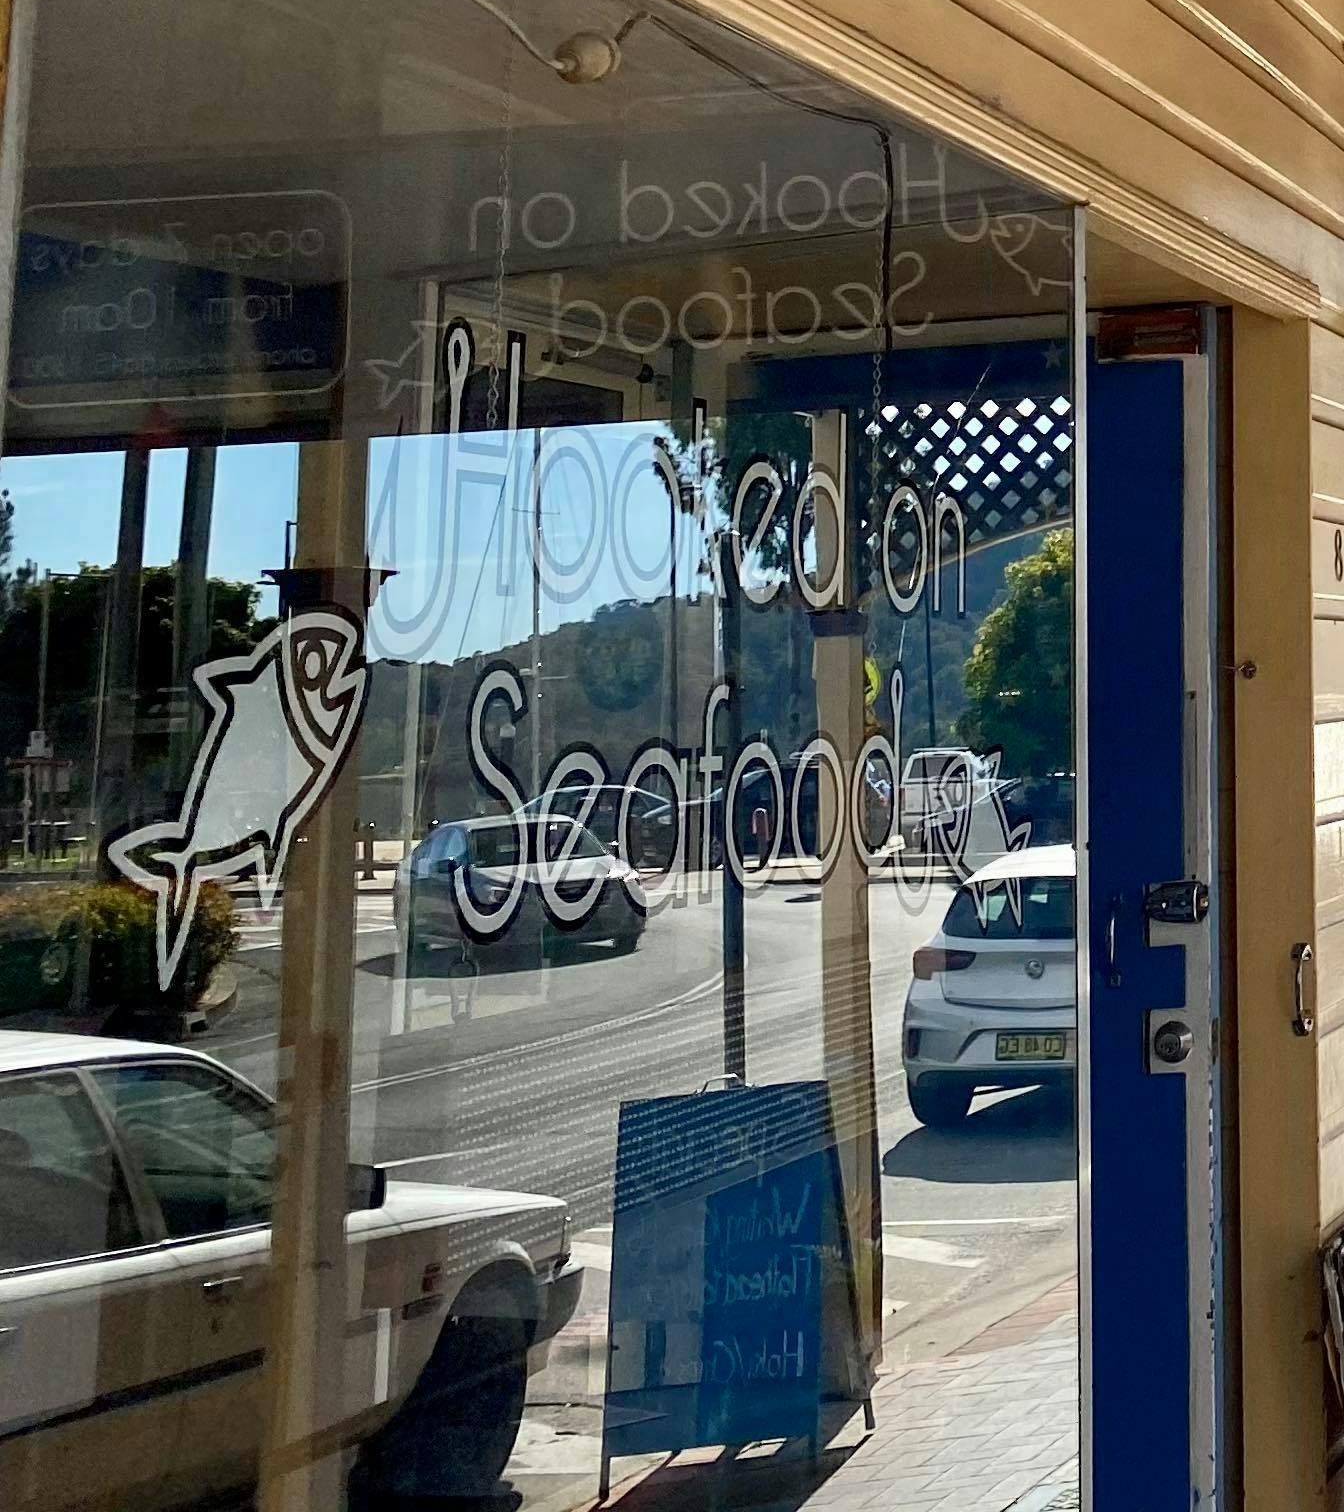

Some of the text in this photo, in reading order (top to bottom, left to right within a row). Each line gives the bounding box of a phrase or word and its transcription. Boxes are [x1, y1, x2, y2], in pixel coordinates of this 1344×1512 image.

[366, 317, 967, 662] Hooked on
[449, 660, 937, 944] Seafood
